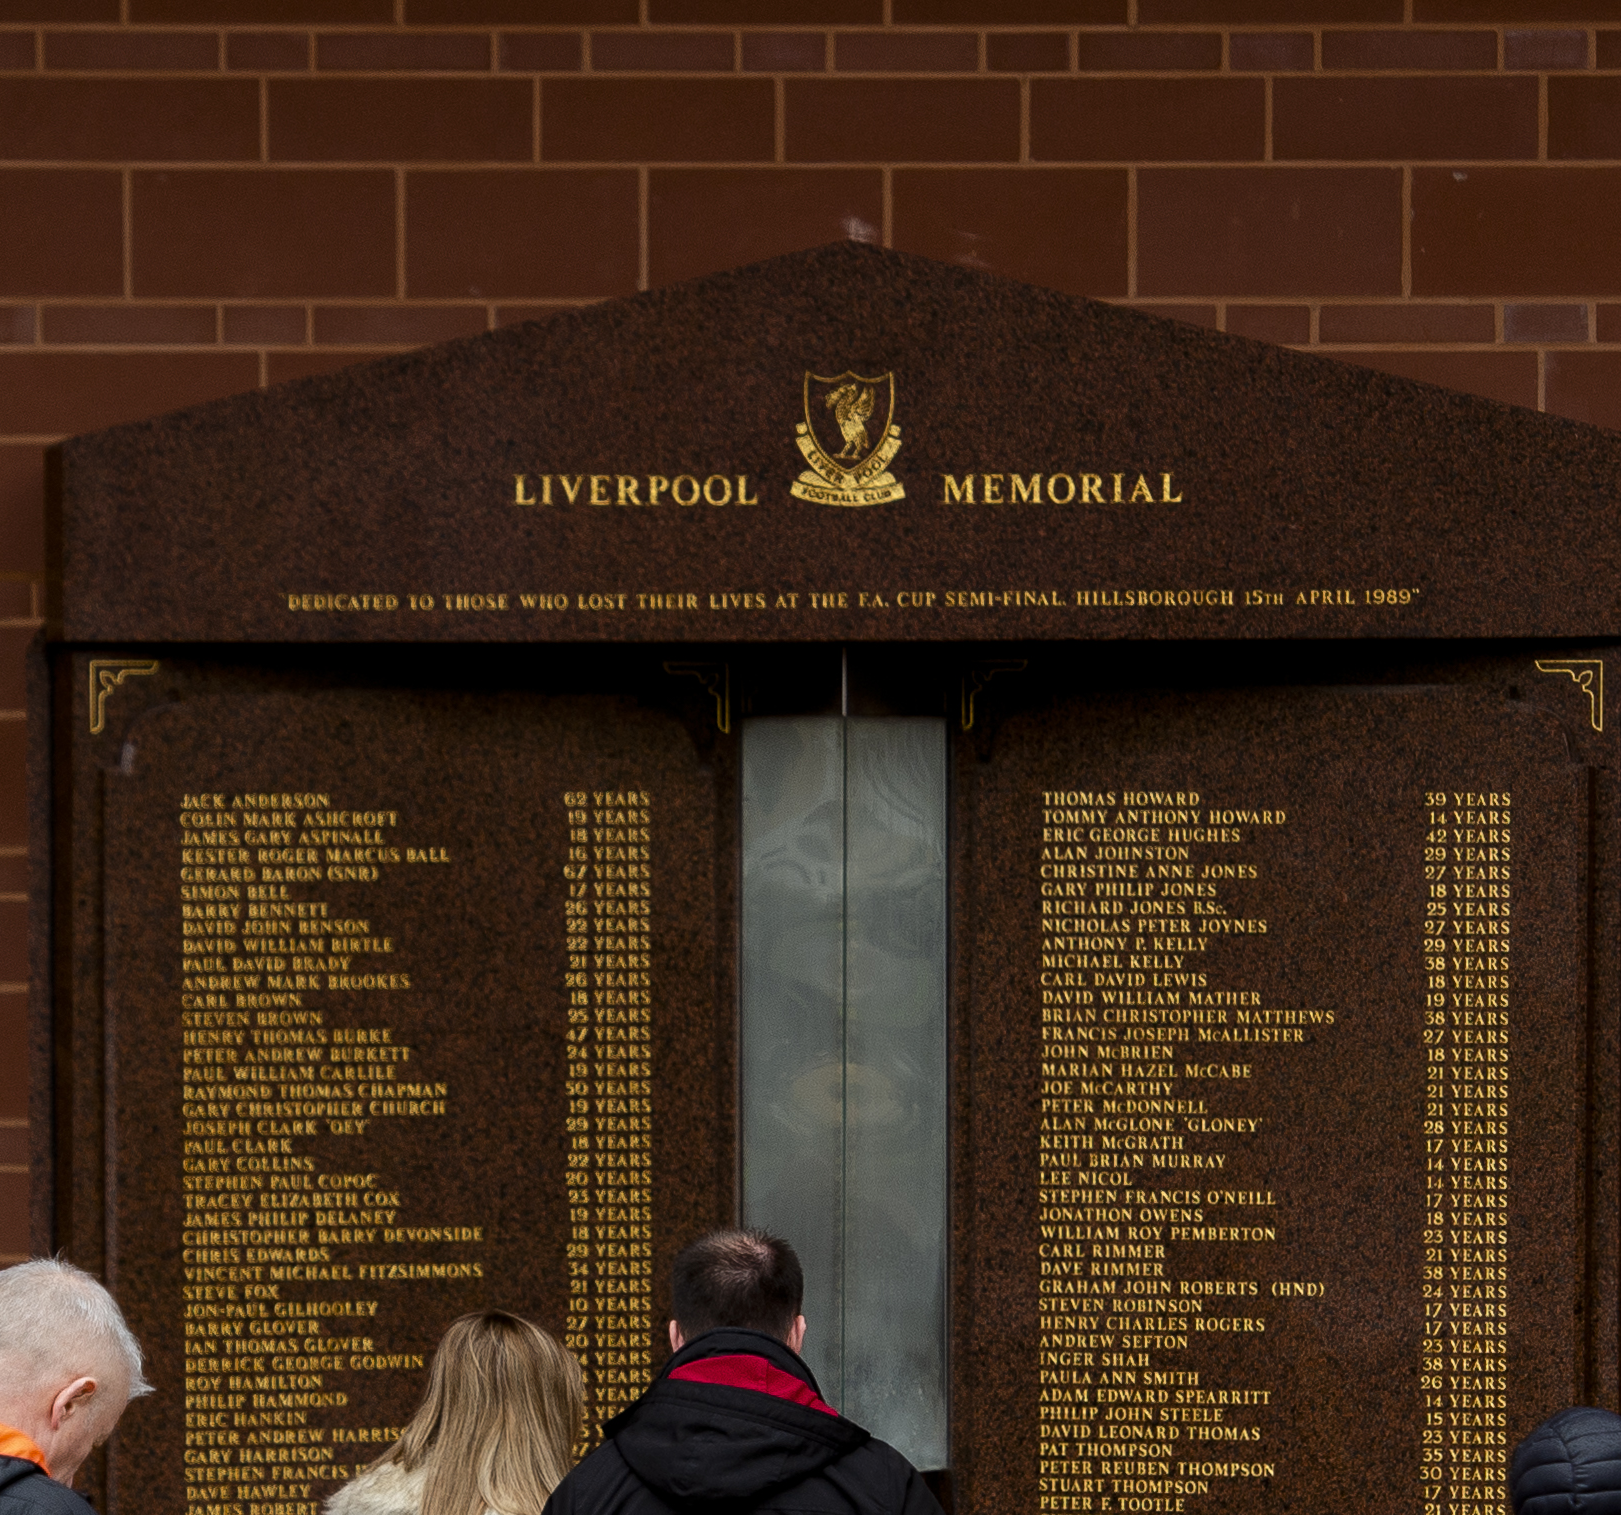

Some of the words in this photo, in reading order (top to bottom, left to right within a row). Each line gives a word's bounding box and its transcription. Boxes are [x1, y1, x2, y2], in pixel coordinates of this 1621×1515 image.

[512, 473, 759, 506] LIVERPOOL
[941, 472, 1184, 505] MEMORIAL
[408, 593, 436, 611] TO
[443, 593, 510, 611] THOSE
[519, 592, 570, 610] WHO
[577, 592, 628, 610] LOST
[636, 592, 700, 610] THEIR
[708, 591, 768, 609] LIVES
[774, 591, 801, 609] AT
[809, 591, 849, 609] THE
[895, 590, 938, 608] CUP
[1075, 589, 1235, 607] HILLSBOROUGH
[1294, 588, 1357, 606] APRIL
[180, 794, 226, 809] JACK
[231, 793, 331, 809] ANDERSON
[562, 791, 588, 807] 62
[592, 791, 651, 806] YEARS
[1041, 791, 1118, 806] THOMAS
[1122, 791, 1202, 806] HOWARD
[1424, 792, 1449, 807] 39
[1453, 792, 1513, 807] YEARS
[1042, 810, 1110, 824] TOMMY
[1114, 810, 1203, 824] ANTHONY
[1208, 810, 1288, 824] HOWARD
[1042, 828, 1082, 842] ERIC
[1088, 828, 1162, 842] GEORGE
[1167, 828, 1243, 843] HUGHES
[1425, 829, 1449, 843] 42
[1452, 829, 1513, 843] YEARS
[181, 849, 251, 864] KESTER
[256, 848, 319, 864] ROGER
[324, 848, 402, 862] MARCUS
[405, 847, 451, 863] BALL
[568, 847, 589, 861] 16
[592, 846, 651, 861] YEARS
[1039, 864, 1140, 878] CHRISTINE
[1145, 864, 1196, 879] ANNE
[1200, 864, 1260, 879] JONES
[1423, 865, 1448, 880] 27
[1452, 865, 1512, 880] YEARS
[1040, 918, 1133, 933] NICHOLAS
[1137, 918, 1193, 933] PETER
[1197, 919, 1269, 934] JOYNES
[1423, 919, 1447, 935] 27
[1452, 920, 1512, 935] YEARS
[181, 939, 238, 954] DAVID
[242, 938, 325, 953] WILLIAM
[330, 937, 393, 953] BIRTLE
[565, 936, 589, 951] 22
[593, 936, 652, 950] YEARS
[1041, 954, 1124, 969] MICHAEL
[1129, 955, 1186, 969] KELLY
[1041, 990, 1096, 1004] DAVID
[1100, 991, 1182, 1005] WILLIAM
[1187, 991, 1263, 1006] MATHER
[1425, 992, 1447, 1007] 19
[1451, 993, 1511, 1008] YEARS
[1041, 1008, 1098, 1023] BRIAN
[1101, 1009, 1229, 1024] CHRISTOPHER
[1235, 1010, 1337, 1024] MATTHEWS
[1040, 1063, 1115, 1077] MARIAN
[1120, 1063, 1180, 1078] HAZEL
[1183, 1063, 1253, 1078] McCABE
[182, 1085, 273, 1100] RAYMOND
[279, 1084, 355, 1099] THOMAS
[356, 1083, 448, 1098] CHAPMAN
[564, 1081, 590, 1096] 50
[593, 1080, 652, 1096] YEARS
[1040, 1098, 1096, 1113] PETER
[1101, 1099, 1206, 1114] McDONNELL
[1425, 1102, 1445, 1117] 21
[1450, 1102, 1510, 1117] YEARS
[184, 1193, 254, 1209] TRACEY
[259, 1192, 359, 1208] ELIZABETH
[362, 1191, 401, 1207] COX
[567, 1189, 591, 1204] 23
[594, 1188, 653, 1204] YEARS
[1038, 1189, 1119, 1204] STEPHEN
[1124, 1190, 1203, 1204] FRANCIS
[1206, 1190, 1274, 1204] O'NEILL
[181, 1230, 311, 1245] CHRISTOPHER
[317, 1228, 378, 1243] BARRY
[382, 1227, 483, 1242] DEVONSIDE
[1039, 1225, 1122, 1240] WILLIAM
[1126, 1225, 1165, 1240] ROY
[1169, 1226, 1278, 1241] PEMBERTON
[1422, 1229, 1446, 1244] 23
[1449, 1230, 1509, 1244] YEARS
[183, 1266, 264, 1282] VINCENT
[268, 1265, 352, 1281] MICHAEL
[357, 1264, 485, 1279] FITZSIMMONS
[568, 1261, 590, 1276] 34
[594, 1260, 653, 1276] YEARS
[1037, 1279, 1118, 1294] GRAHAM
[1122, 1280, 1173, 1295] JOHN
[1178, 1280, 1260, 1295] ROBERTS
[1270, 1282, 1327, 1296] (HND)
[183, 1339, 219, 1355] IAN
[222, 1338, 300, 1353] THOMAS
[302, 1337, 375, 1353] GLOVER
[564, 1333, 590, 1348] 20
[594, 1332, 653, 1348] YEARS
[1038, 1351, 1096, 1366] INGER
[1100, 1352, 1151, 1367] SHAH
[1422, 1357, 1445, 1372] 38
[1449, 1357, 1509, 1372] YEARS
[1038, 1406, 1101, 1421] PHILIP
[1104, 1407, 1155, 1421] JOHN
[1158, 1407, 1225, 1421] STEELE
[1038, 1460, 1094, 1475] PETER
[1100, 1461, 1172, 1475] REUBEN
[1176, 1461, 1277, 1475] THOMPSON
[1418, 1466, 1445, 1481] 30
[1449, 1467, 1508, 1481] YEARS
